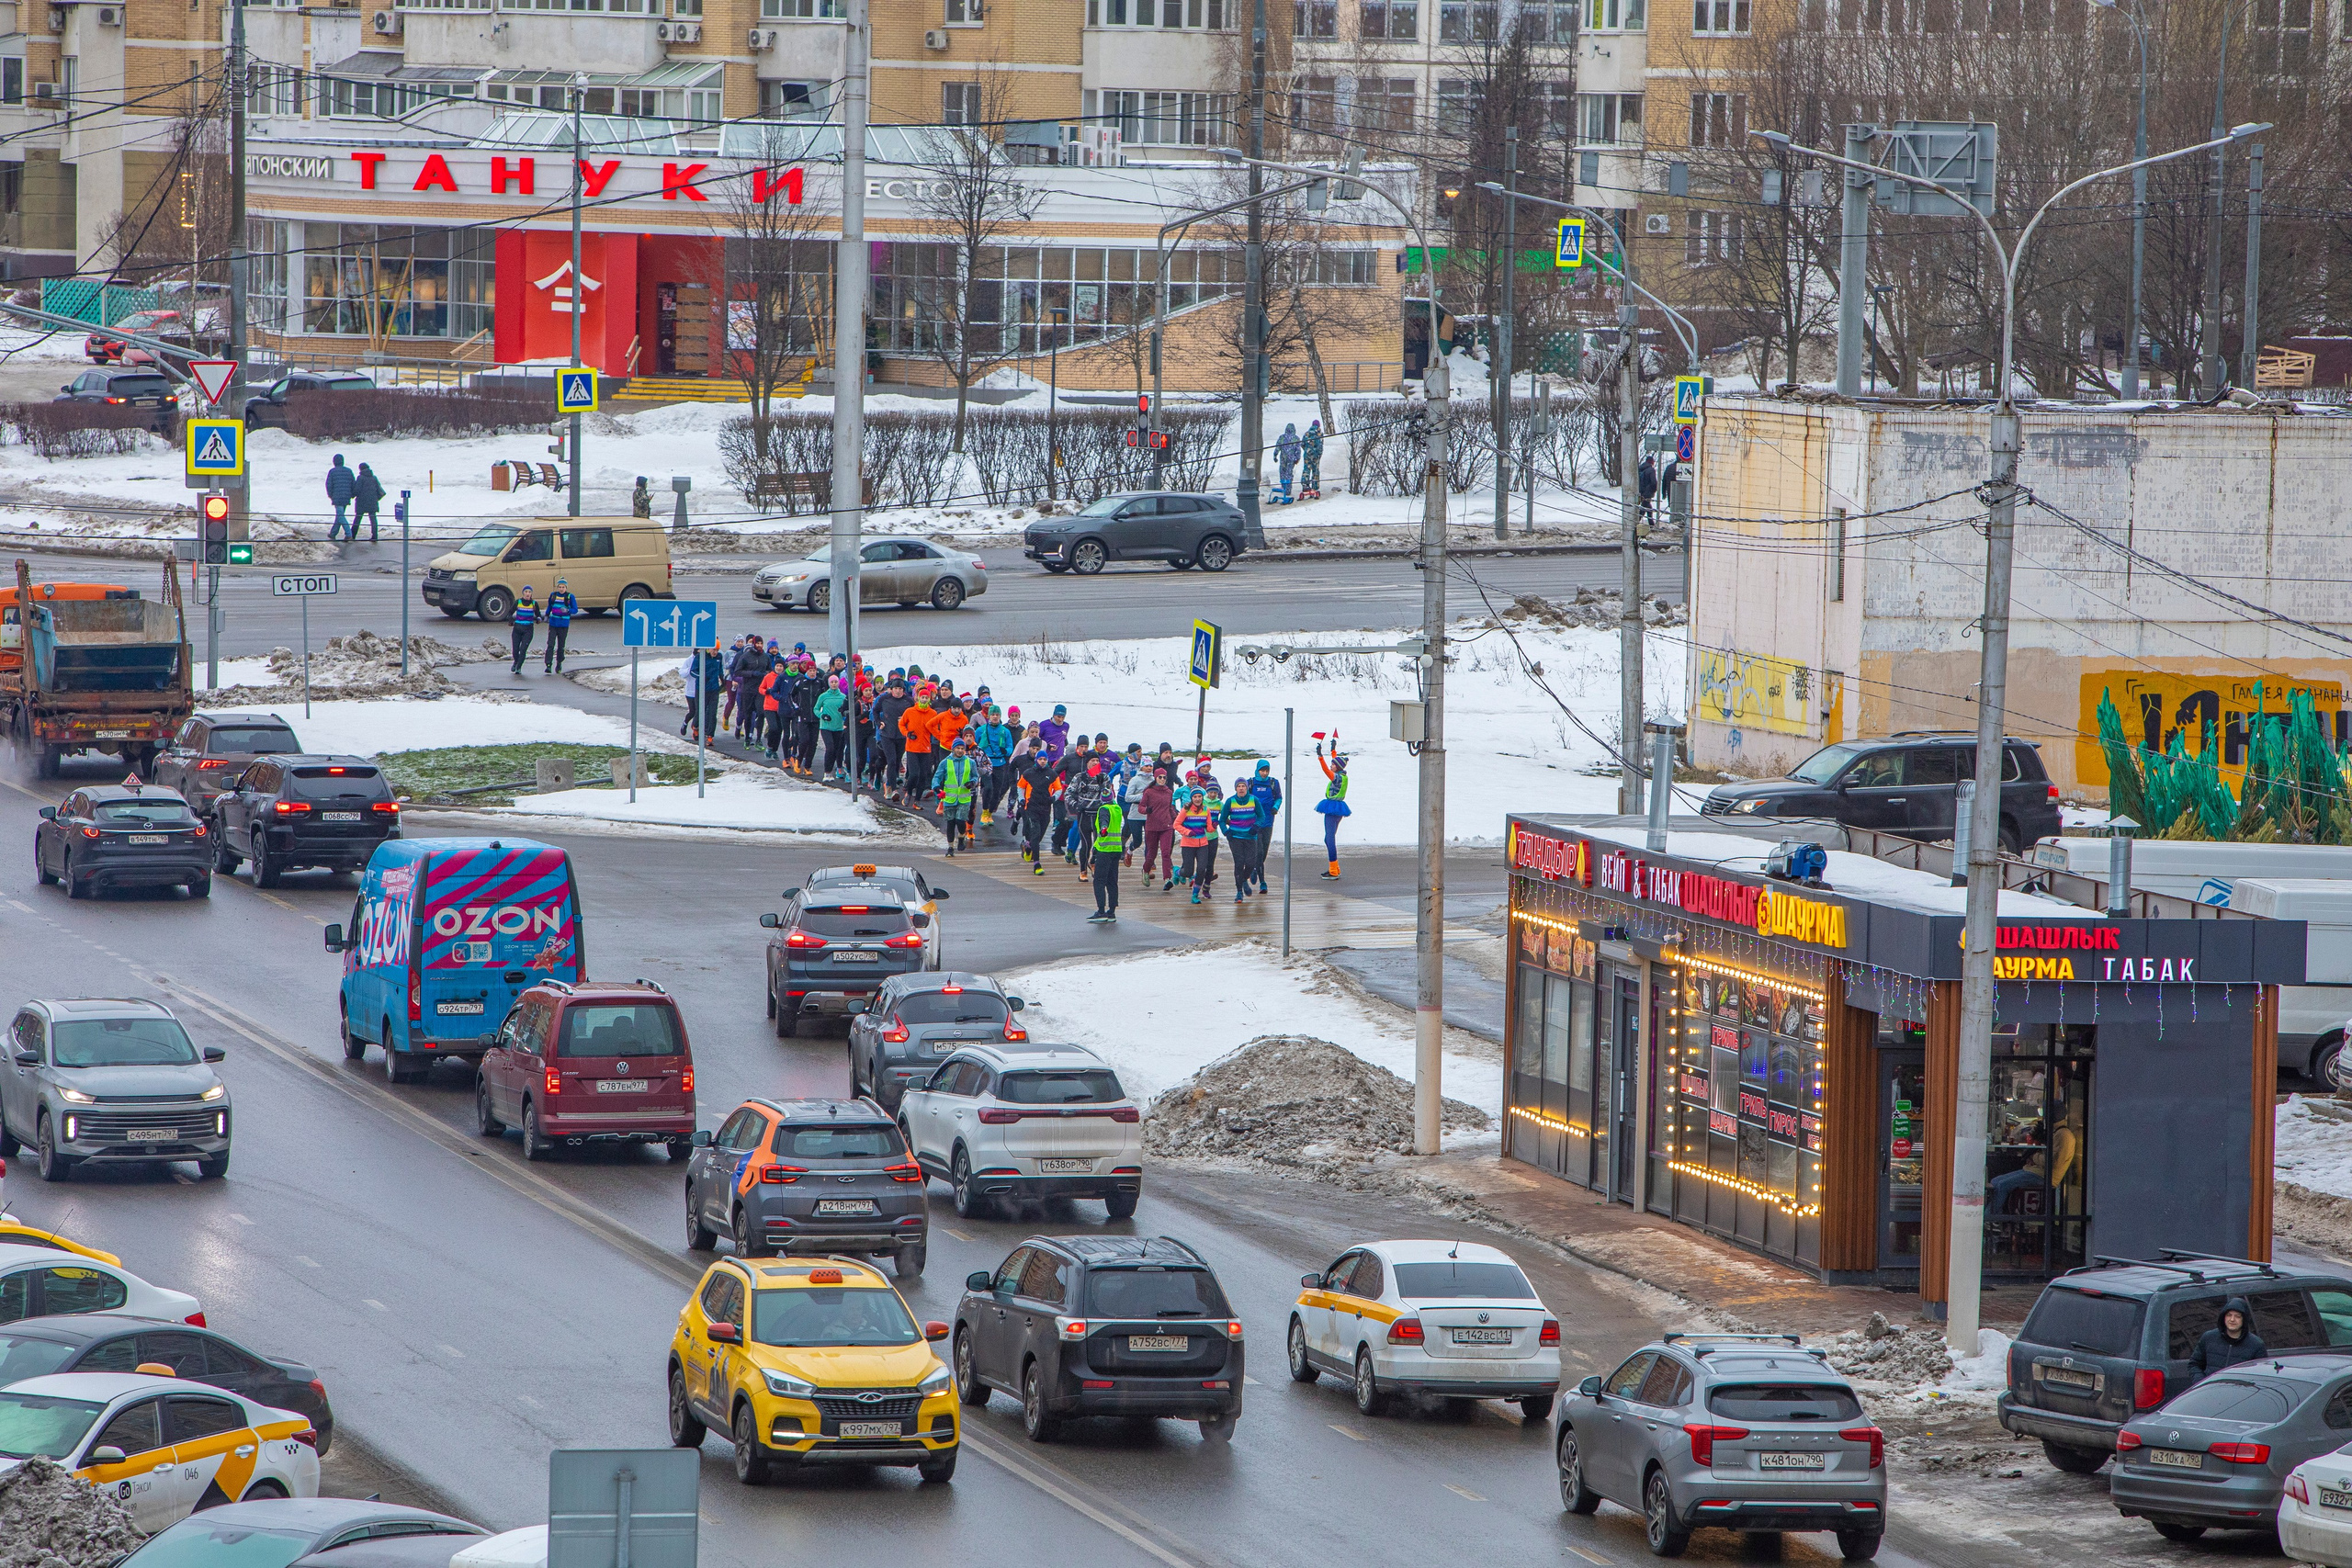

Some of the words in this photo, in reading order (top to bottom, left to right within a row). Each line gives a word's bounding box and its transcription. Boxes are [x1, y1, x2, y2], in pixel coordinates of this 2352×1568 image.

[351, 152, 804, 205] ТАНУКИ
[280, 578, 329, 592] СТОП
[1518, 831, 1577, 880] ТАНДЫР
[1601, 851, 1626, 892] ВЕЙП
[1649, 867, 1680, 908] ТАБАК
[1684, 871, 1760, 929] ШАШЛЫК
[1771, 892, 1847, 948] ШАУРМА
[360, 899, 413, 966] OZON
[434, 906, 560, 936] OZON
[1996, 926, 2120, 950] ШАШЛЫК
[1993, 957, 2075, 980] АУРМА
[2103, 957, 2194, 981] ТАБАК
[1712, 1025, 1738, 1049] ГРИЛЬ
[1739, 1091, 1768, 1119] ГРИЛЬ
[1769, 1110, 1797, 1138] ГИРОС
[185, 1468, 198, 1482] 046
[119, 1484, 130, 1497] Go
[132, 1482, 151, 1495] Такси
[2323, 1493, 2352, 1506] Е932У
